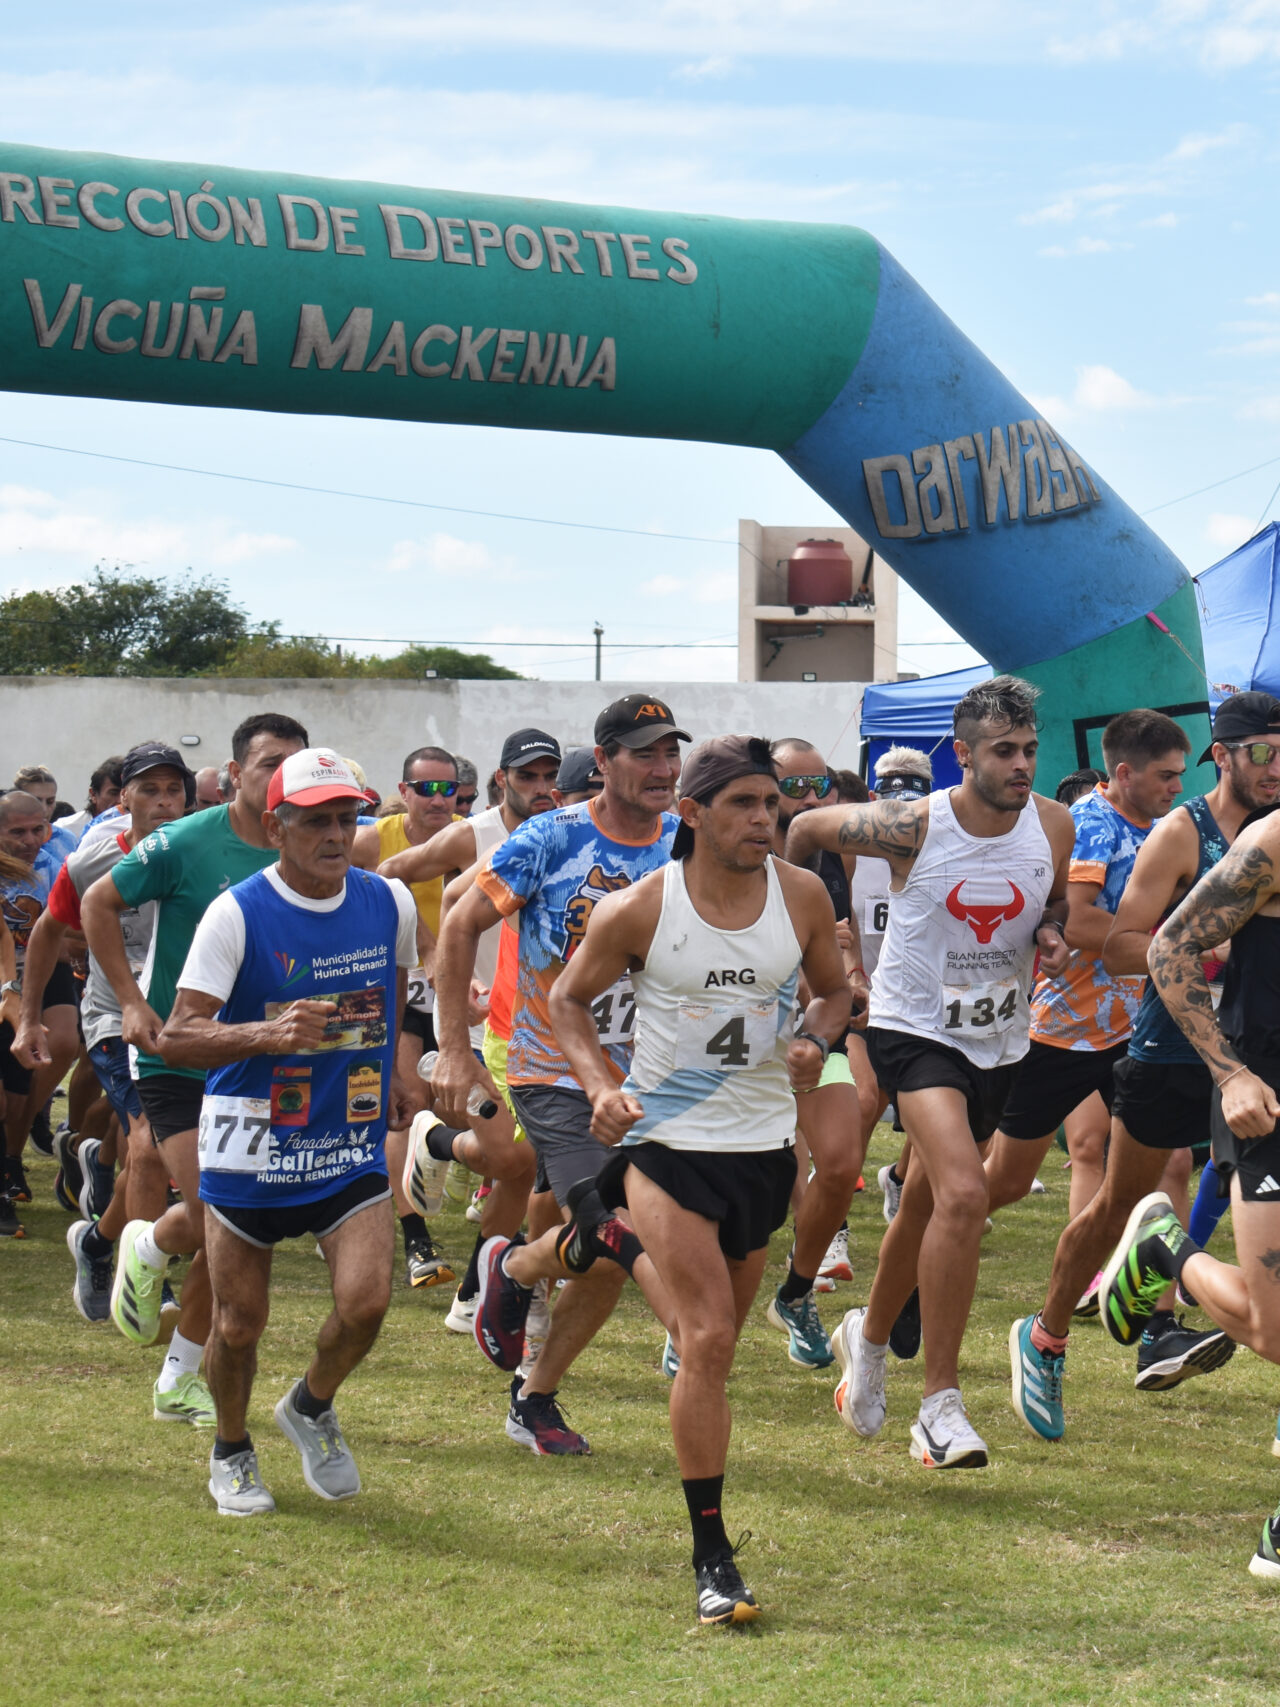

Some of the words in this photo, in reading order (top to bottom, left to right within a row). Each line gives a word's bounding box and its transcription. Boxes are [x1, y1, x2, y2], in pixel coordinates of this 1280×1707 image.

[277, 193, 366, 255] DE
[379, 204, 699, 285] DEPORTES
[23, 278, 259, 365] VICUÑA
[290, 303, 617, 391] MACKENNA
[521, 742, 555, 751] SALOMON
[567, 898, 594, 934] 3
[312, 945, 377, 968] Municipalidad
[378, 944, 387, 955] de
[314, 966, 350, 980] Huinca
[352, 956, 387, 973] Renancó
[946, 951, 977, 961] GIAN
[947, 961, 989, 970] RUNNING
[704, 968, 756, 988] ARG
[944, 989, 1018, 1029] 134
[705, 1016, 750, 1066] 4
[256, 1173, 302, 1184] HUINCA
